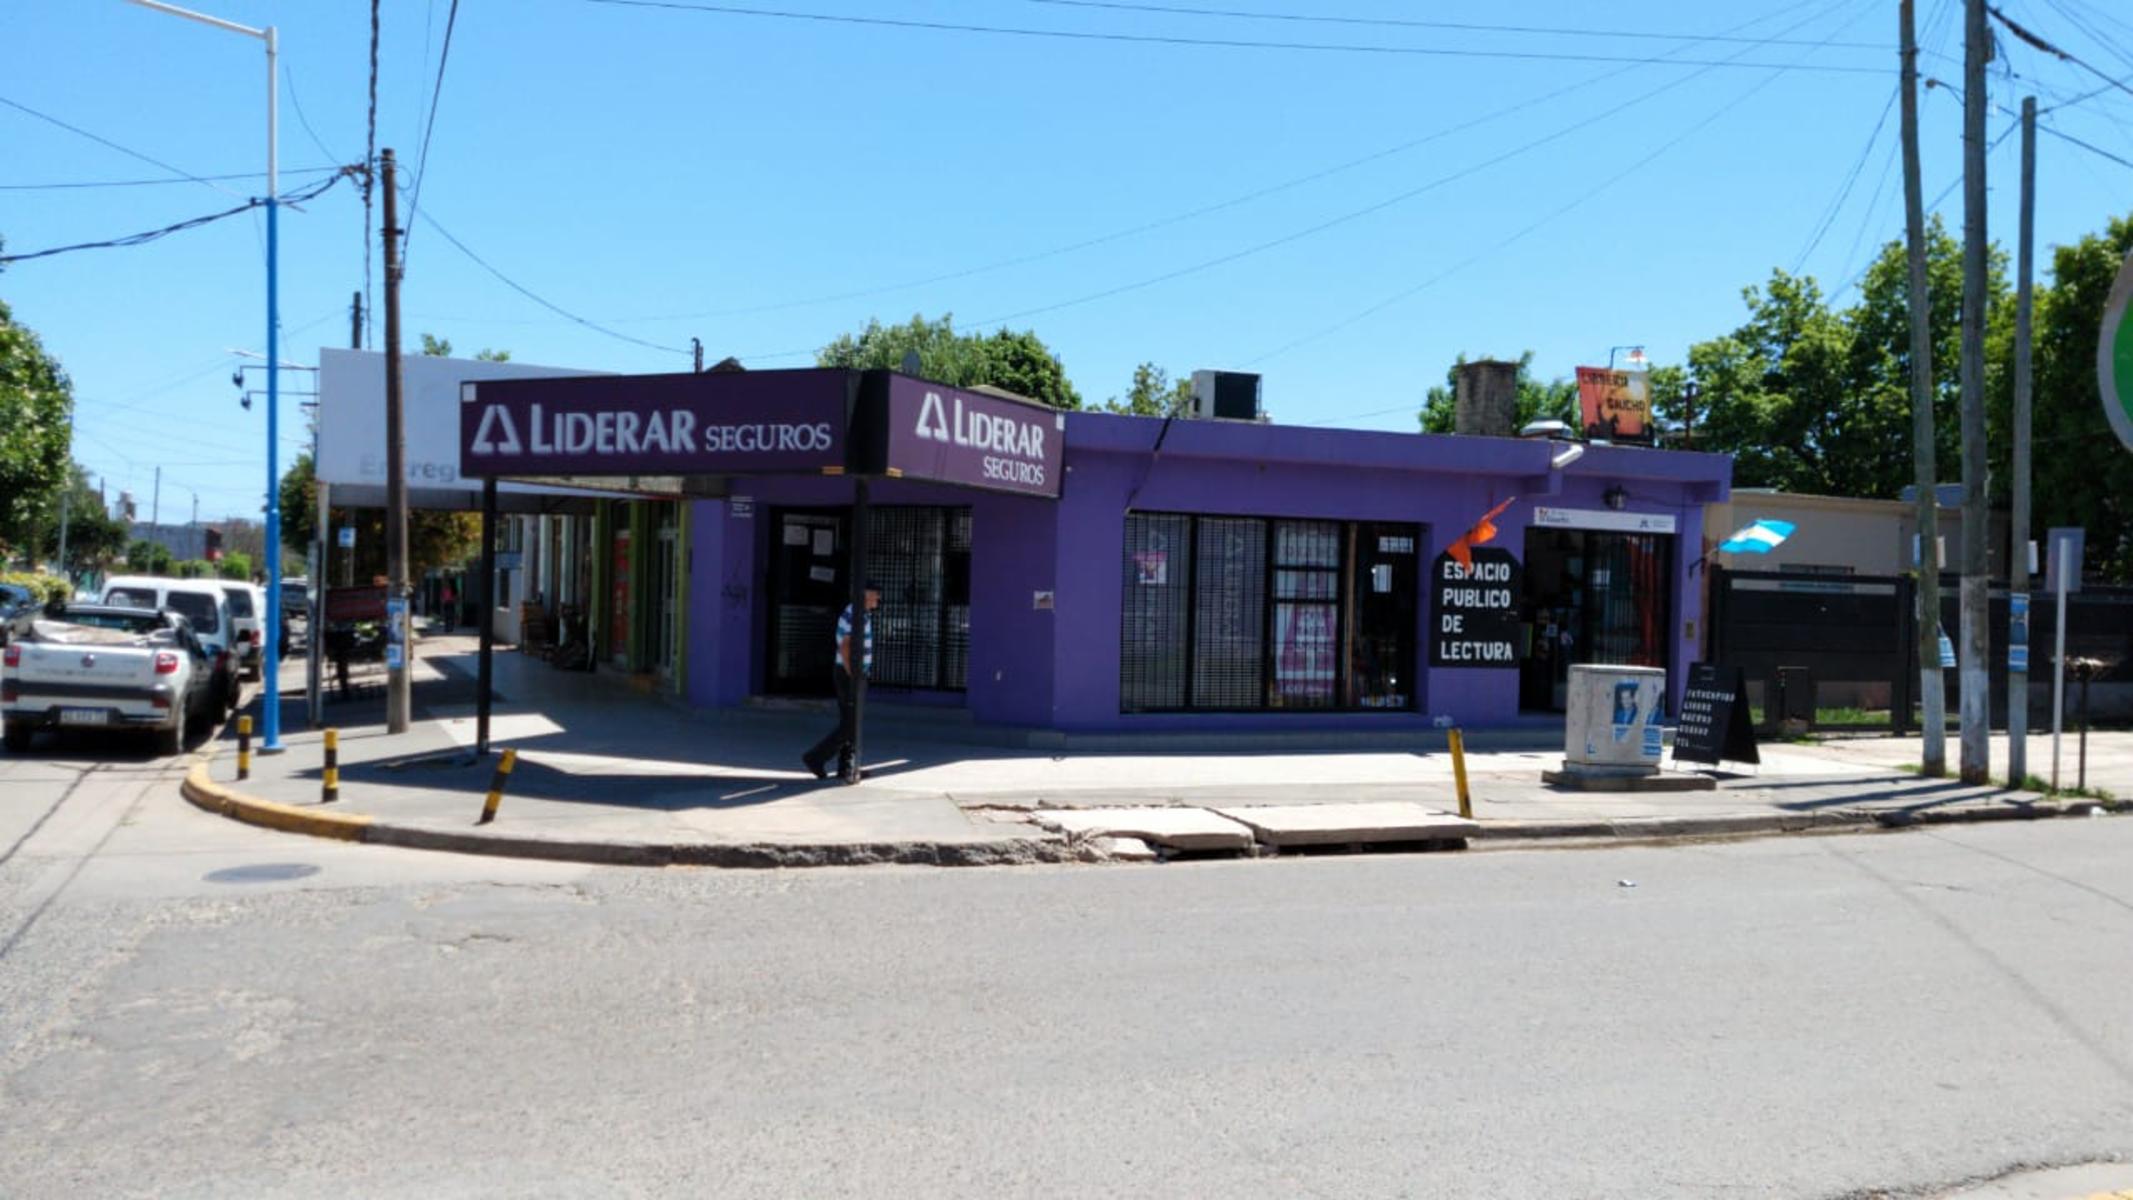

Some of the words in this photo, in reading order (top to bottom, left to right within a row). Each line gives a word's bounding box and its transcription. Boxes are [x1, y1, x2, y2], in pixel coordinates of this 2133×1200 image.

[530, 403, 696, 453] LIDERAR
[706, 423, 831, 451] SEGUROS
[954, 398, 1044, 459] LIDERAR
[983, 455, 1044, 486] SEGUROS
[1442, 588, 1511, 608] PUBLICO
[1442, 614, 1463, 633] DE
[1440, 640, 1513, 660] LECTURA
